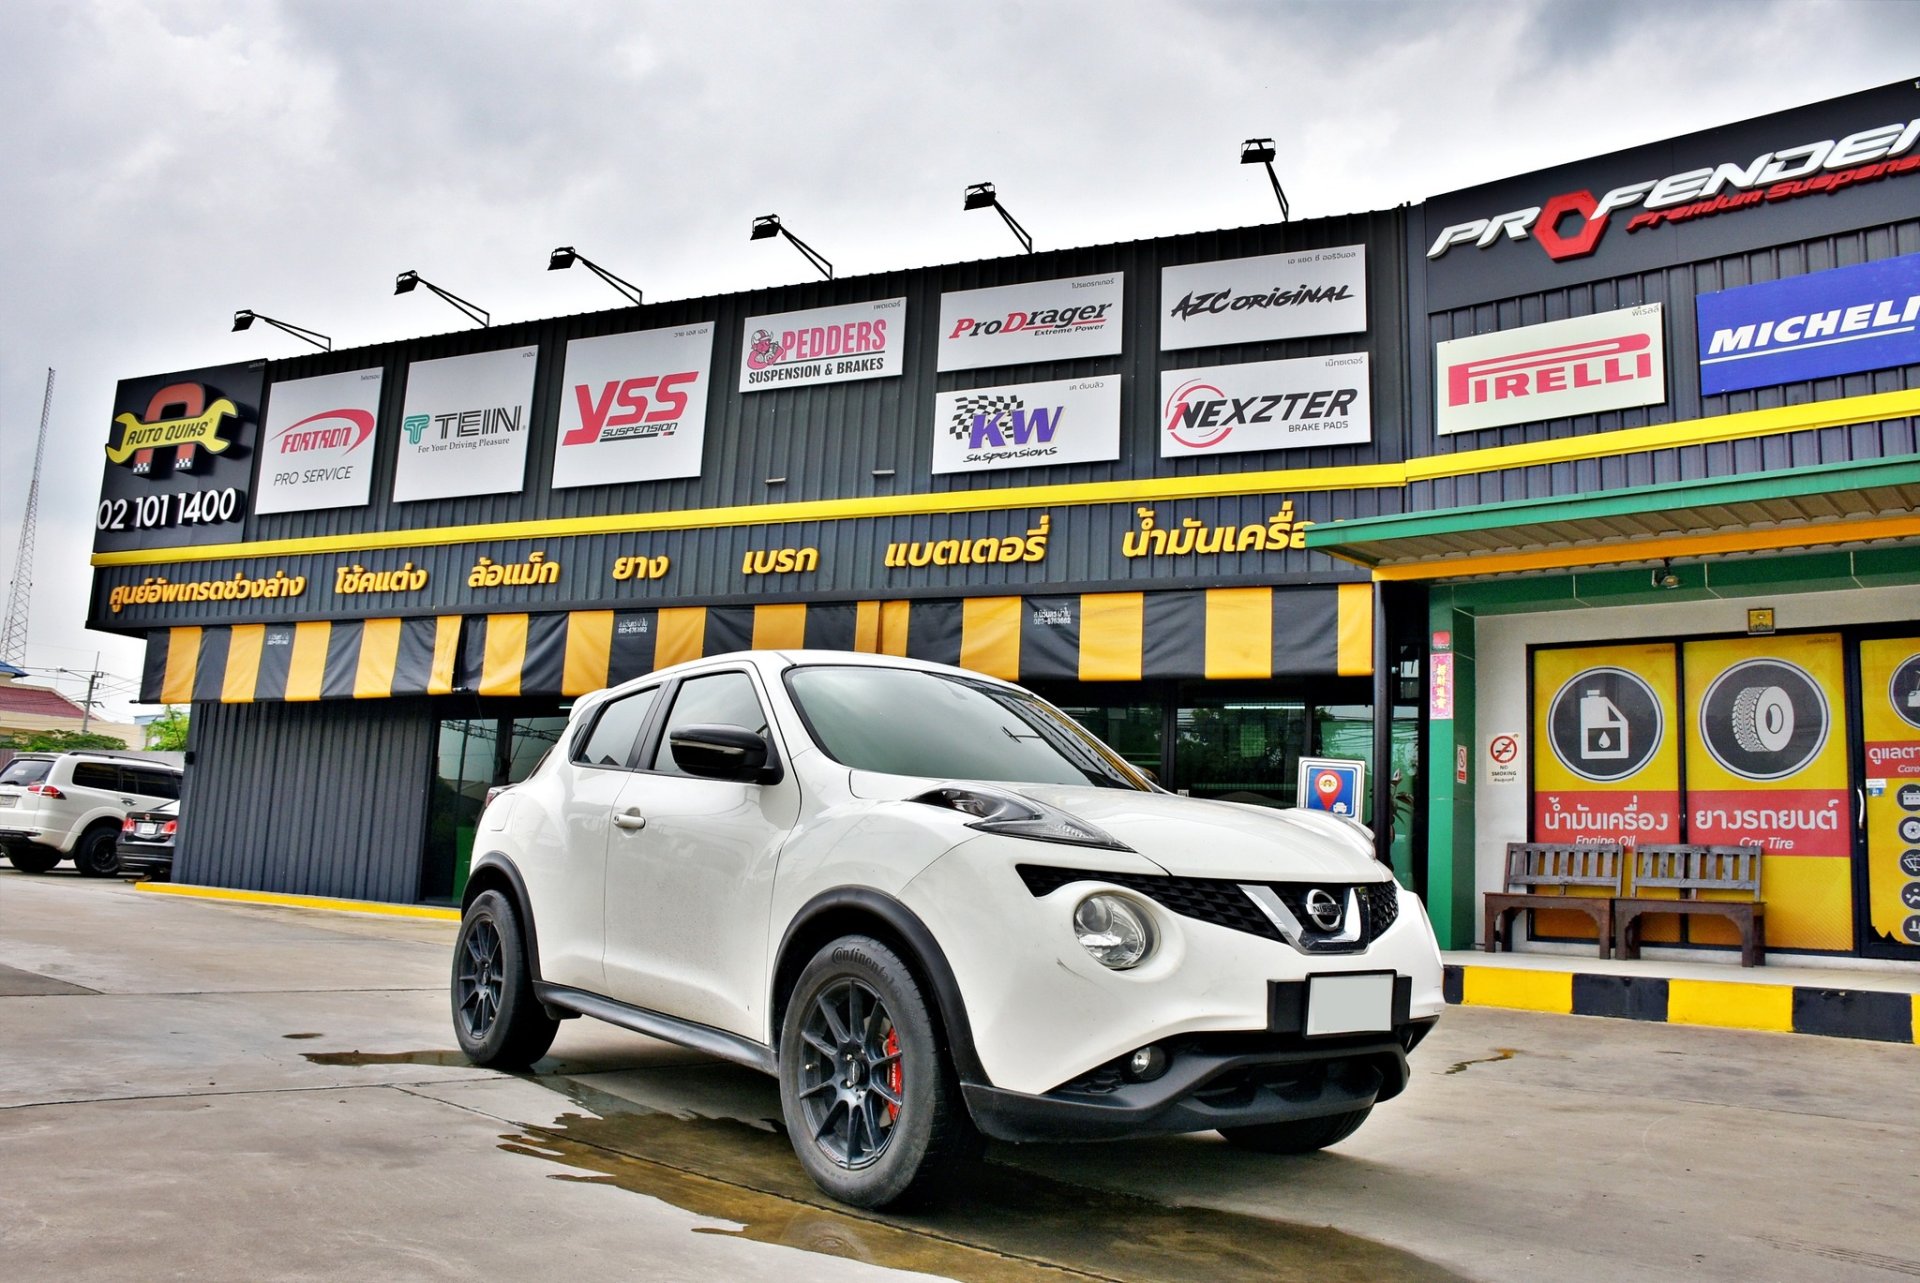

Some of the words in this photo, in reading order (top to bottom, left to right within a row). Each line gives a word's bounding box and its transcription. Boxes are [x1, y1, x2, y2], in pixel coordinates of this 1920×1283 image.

[1626, 190, 1764, 232] Premium
[1765, 154, 1920, 199] Suspens
[1171, 288, 1231, 322] AZC
[949, 302, 1113, 341] ProDrager
[1034, 326, 1072, 337] Extreme
[1074, 324, 1104, 334] Power
[781, 318, 887, 361] PEDDERS
[748, 364, 821, 384] SUSPENSION
[824, 362, 834, 376] &
[836, 357, 884, 375] BRAKES
[1448, 333, 1652, 408] PIRELLI
[435, 405, 523, 440] TEIN
[562, 371, 699, 446] YSS
[1167, 388, 1358, 430] NEXZTER
[126, 427, 163, 446] AUTO
[164, 421, 208, 442] QUIKS
[281, 427, 352, 454] FORTRON
[601, 422, 678, 438] SUSPENSION
[968, 405, 1064, 450] KW
[1288, 422, 1320, 433] BRAKE
[1323, 420, 1348, 431] PADS
[418, 444, 430, 453] For
[431, 441, 447, 452] Your
[449, 438, 477, 451] Driving
[479, 436, 510, 447] Pleasure
[963, 446, 1058, 464] suspensions
[274, 471, 298, 486] PRO
[302, 466, 353, 484] SERVICE
[97, 499, 127, 529] 02
[135, 495, 169, 527] 101
[177, 487, 236, 524] 1400
[109, 570, 306, 613] ศูนย์อัพเกรดช่วงล่าง
[335, 562, 428, 594] โช้คแต่ง
[468, 551, 560, 588] ล้อแม็ก
[612, 554, 670, 581] ยาง
[742, 547, 819, 575] เบรก
[884, 514, 1051, 568] แบตเตอรี่
[1122, 500, 1344, 558] น้ำมันเครื่อ
[1545, 795, 1668, 830] น้ำมันเครื่อง
[1695, 799, 1839, 830] ยางรถยนต์
[1618, 835, 1636, 846] Oil
[1740, 837, 1764, 847] Car
[1768, 837, 1794, 849] Tire
